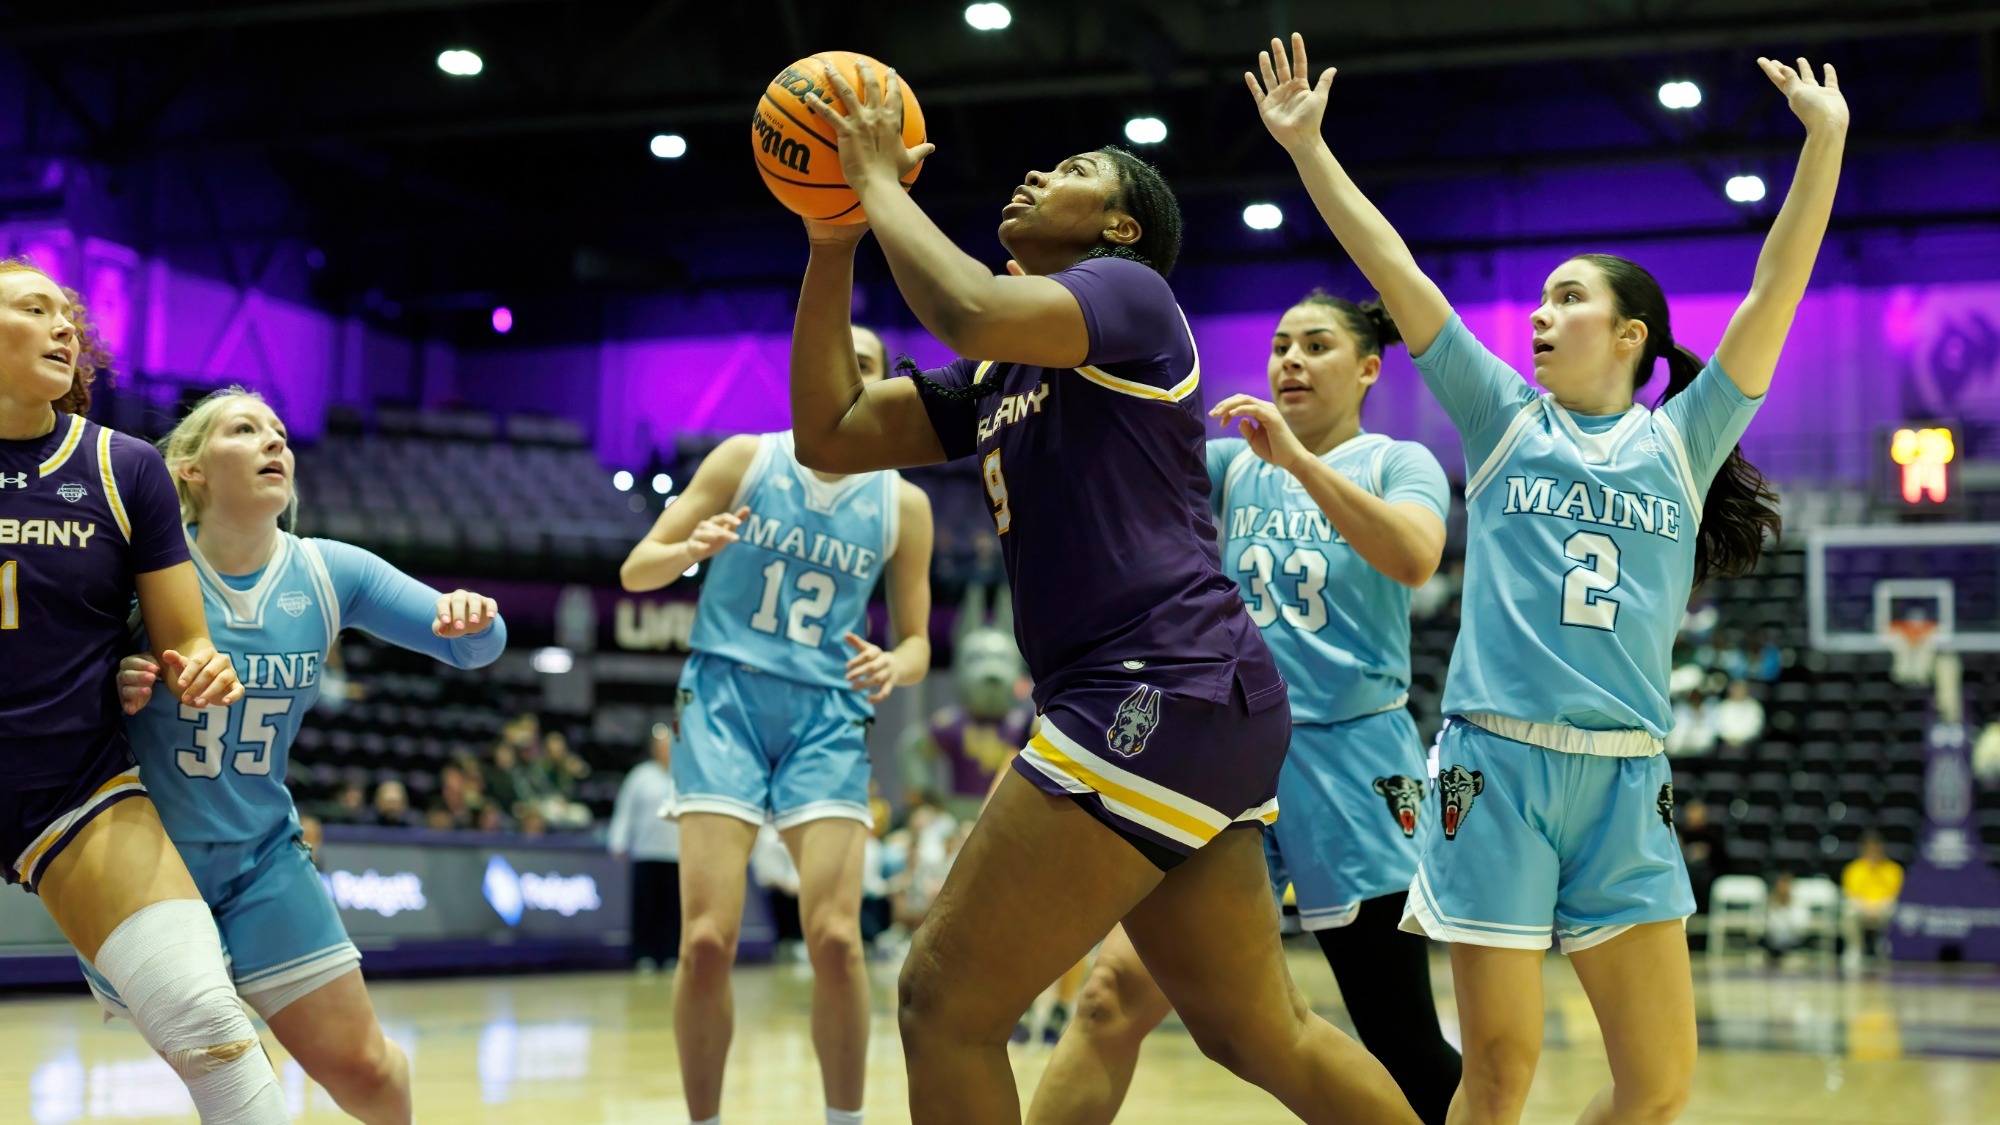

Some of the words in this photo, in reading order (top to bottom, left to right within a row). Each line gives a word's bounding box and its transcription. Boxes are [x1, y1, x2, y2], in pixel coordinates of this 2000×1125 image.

[983, 447, 1011, 537] 9
[1229, 505, 1349, 546] MAIN
[1503, 475, 1680, 543] MAINE
[743, 513, 878, 580] MAINE
[1236, 543, 1330, 633] 33
[1560, 529, 1621, 633] 2
[750, 558, 837, 649] 12
[175, 696, 294, 780] 35
